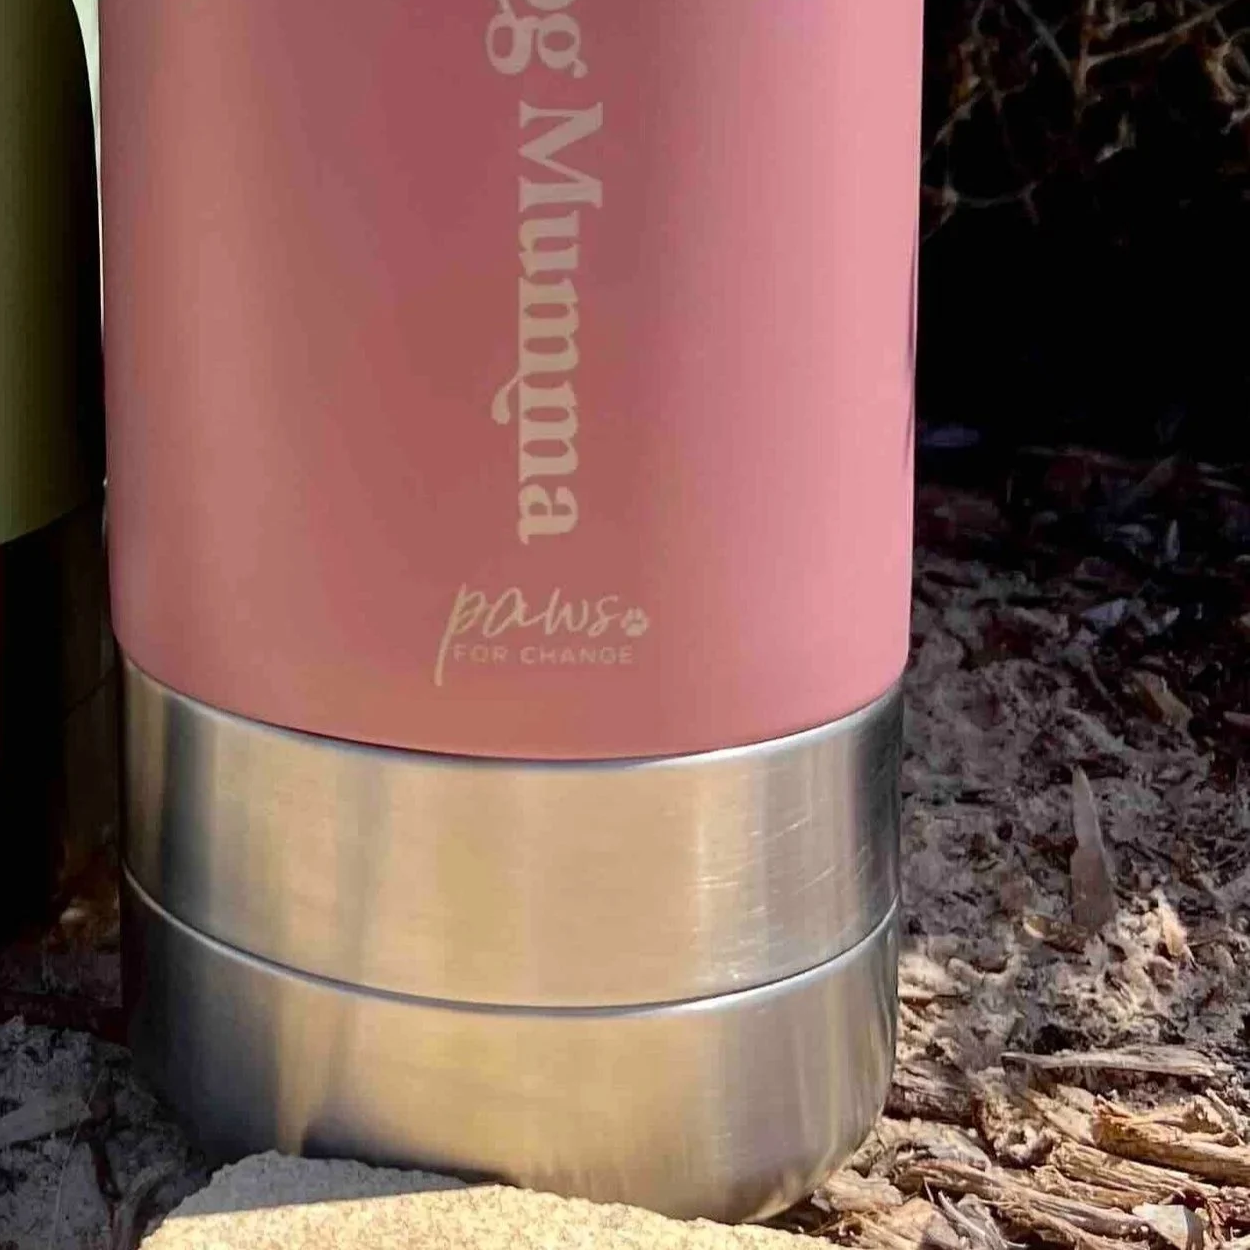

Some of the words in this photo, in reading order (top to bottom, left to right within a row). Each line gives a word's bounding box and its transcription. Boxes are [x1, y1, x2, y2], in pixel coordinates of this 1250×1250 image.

[491, 101, 605, 545] Mumma
[434, 582, 623, 687] paws
[453, 645, 507, 664] FOR
[519, 645, 635, 665] CHANGE
